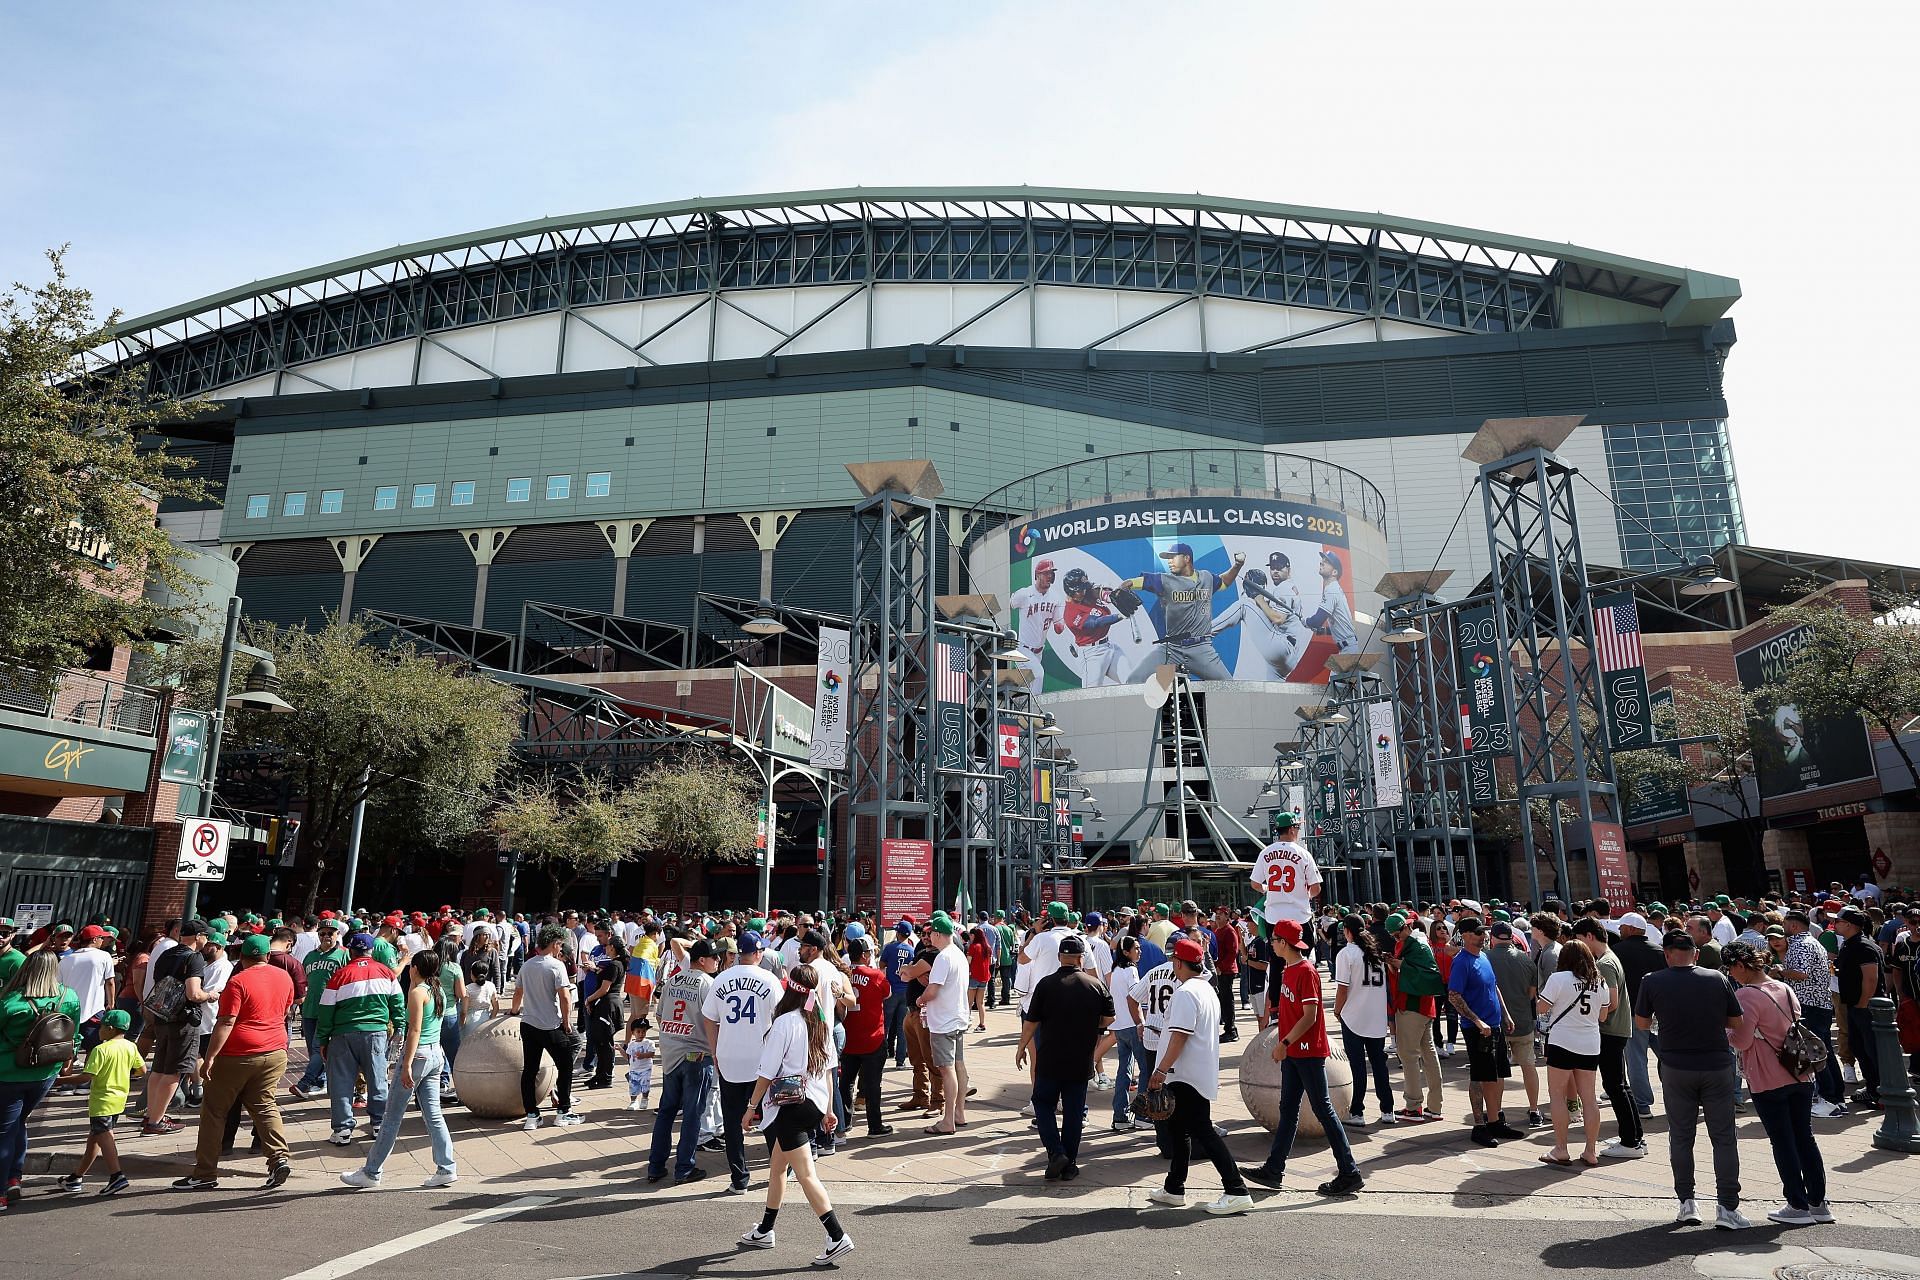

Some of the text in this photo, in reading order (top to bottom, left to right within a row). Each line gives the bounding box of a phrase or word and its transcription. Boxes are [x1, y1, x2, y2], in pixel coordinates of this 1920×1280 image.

[1044, 508, 1343, 541] WORLD BASEBALL CLASSIC 2023
[1459, 618, 1497, 649] 20
[1759, 624, 1818, 665] MORGAN
[819, 636, 850, 664] 20
[1474, 679, 1484, 713] CLASSIC
[1480, 678, 1490, 719] BASEBALL
[1486, 677, 1495, 706] WORLD
[177, 717, 199, 728] 2001
[820, 693, 828, 727] CLASSIC
[826, 694, 834, 734] BASEBALL
[832, 695, 840, 724] WORLD
[1369, 708, 1394, 730] 20
[1612, 675, 1643, 744] USA
[941, 707, 961, 768] USA
[1470, 723, 1510, 753] 23
[810, 739, 846, 767] 23
[1320, 760, 1337, 777] 20
[1003, 770, 1017, 815] CAN
[1377, 784, 1401, 805] 23
[1816, 802, 1867, 819] TICKETS
[1323, 818, 1341, 834] 23
[1657, 833, 1686, 845] TICKETS
[1263, 850, 1302, 865] GONZALEZ
[1268, 864, 1296, 893] 23
[1362, 957, 1384, 987] 15
[715, 977, 771, 1000] VALENZUELA
[1149, 984, 1174, 1014] 16
[673, 1000, 687, 1021] 2
[725, 995, 757, 1025] 34
[1579, 994, 1591, 1016] 5
[661, 1021, 695, 1035] TECATE
[1300, 1042, 1309, 1051] M
